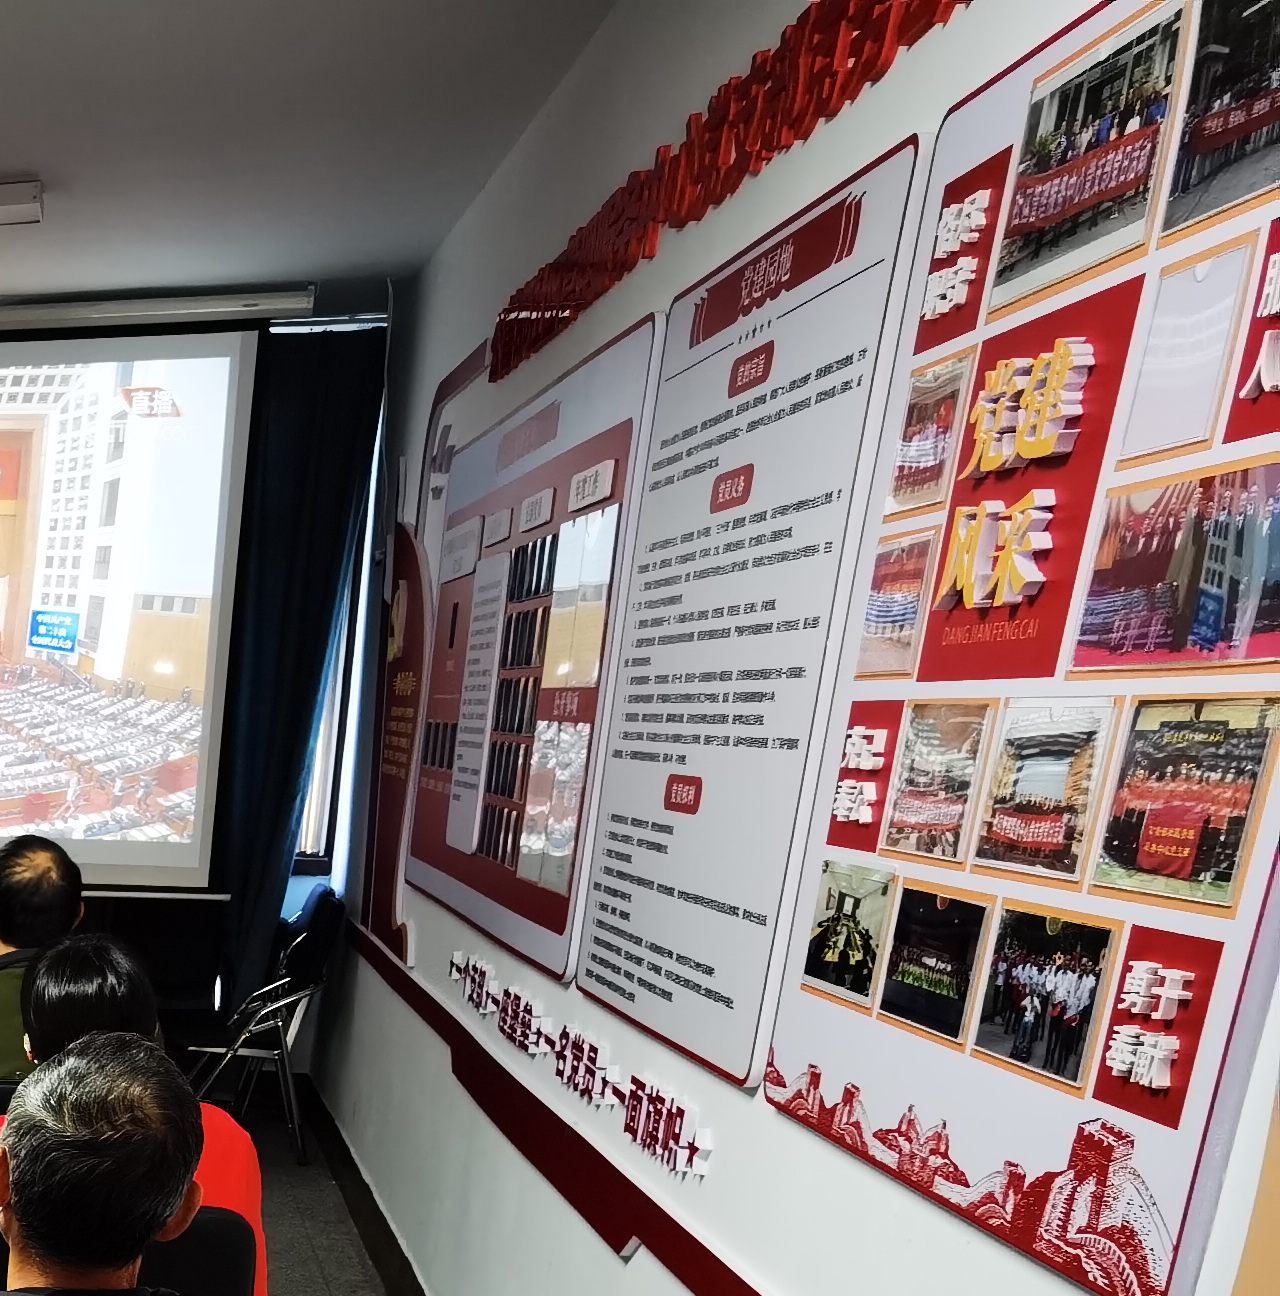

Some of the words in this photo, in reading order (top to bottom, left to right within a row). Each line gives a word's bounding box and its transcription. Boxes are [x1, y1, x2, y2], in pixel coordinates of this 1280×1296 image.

[740, 239, 794, 306] 党建园地
[131, 389, 175, 416] 直播
[957, 337, 1080, 481] 党建
[933, 489, 1053, 611] 风采
[1106, 1025, 1181, 1090] 奉献
